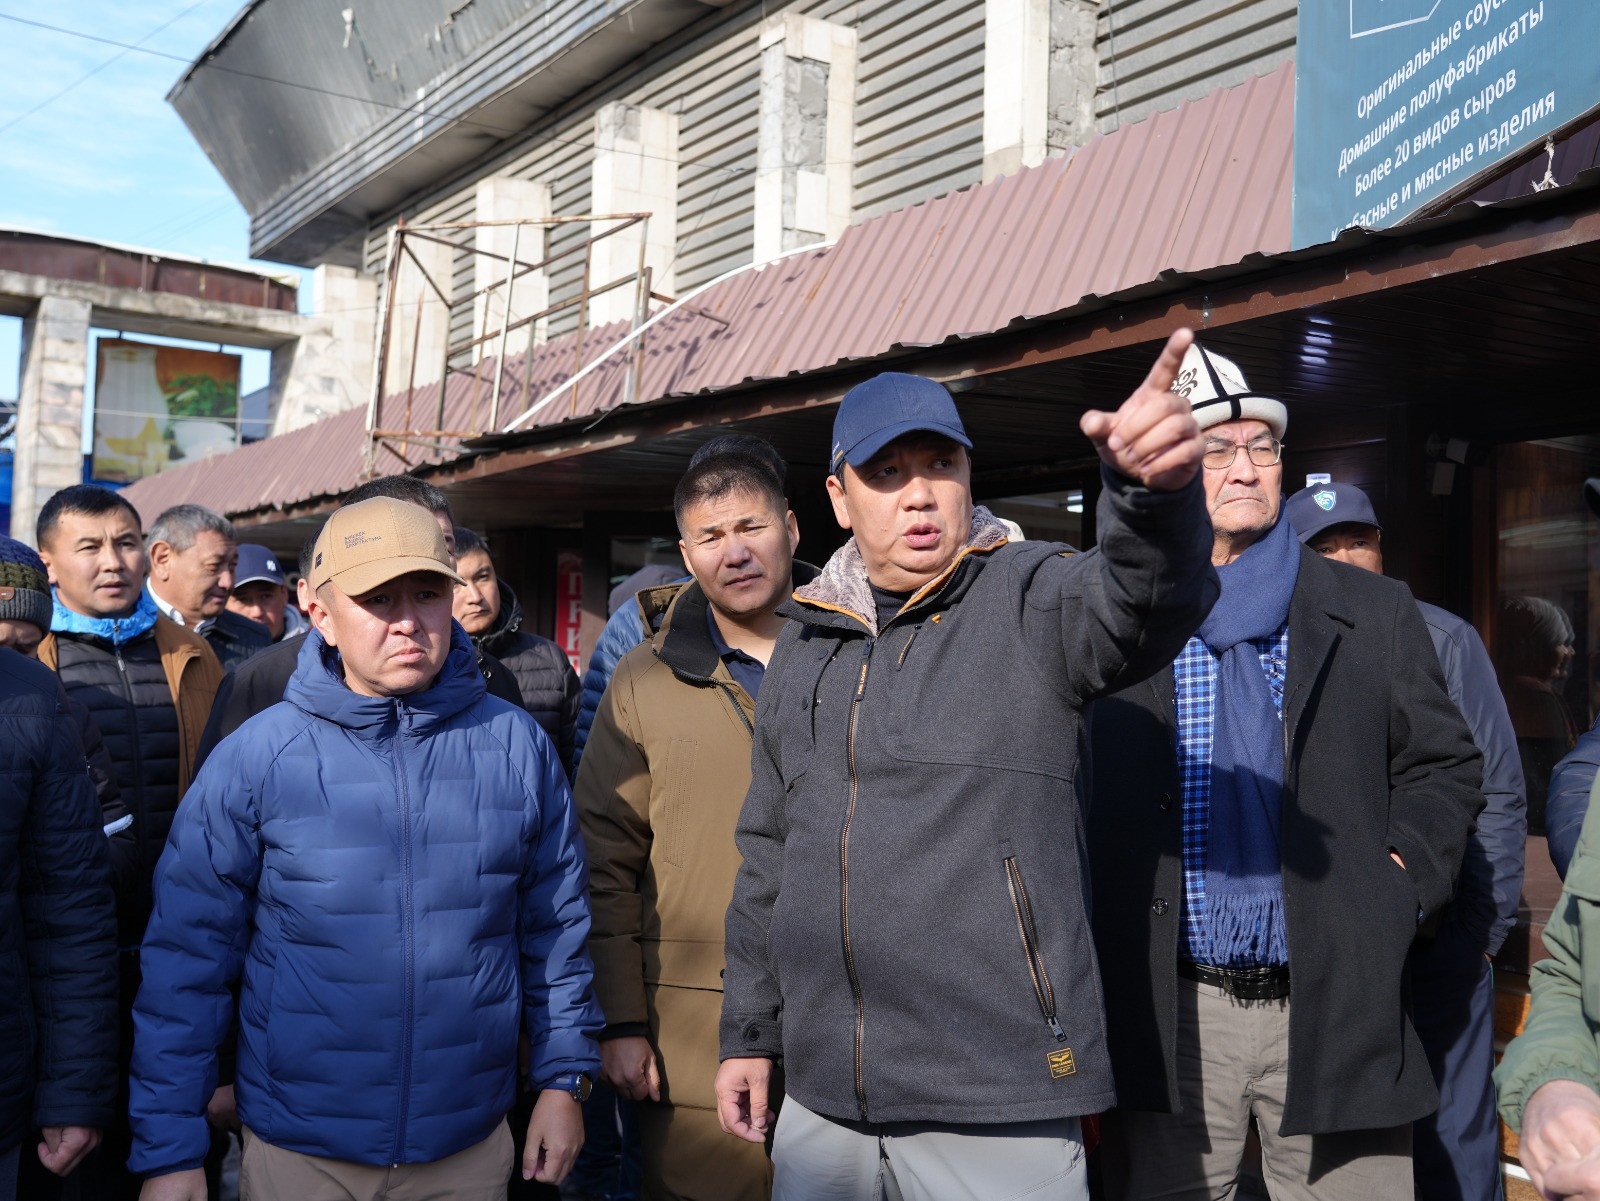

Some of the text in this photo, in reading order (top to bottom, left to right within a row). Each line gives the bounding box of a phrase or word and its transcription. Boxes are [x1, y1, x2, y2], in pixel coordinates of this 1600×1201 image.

[1338, 1, 1544, 178] Домашние полуфабрикаты
[1357, 0, 1509, 119] Оригинальные соус
[1355, 69, 1517, 197] Более 20 видов сыров
[1401, 182, 1411, 203] и
[1414, 142, 1474, 195] мясные
[1478, 90, 1555, 156] изделия
